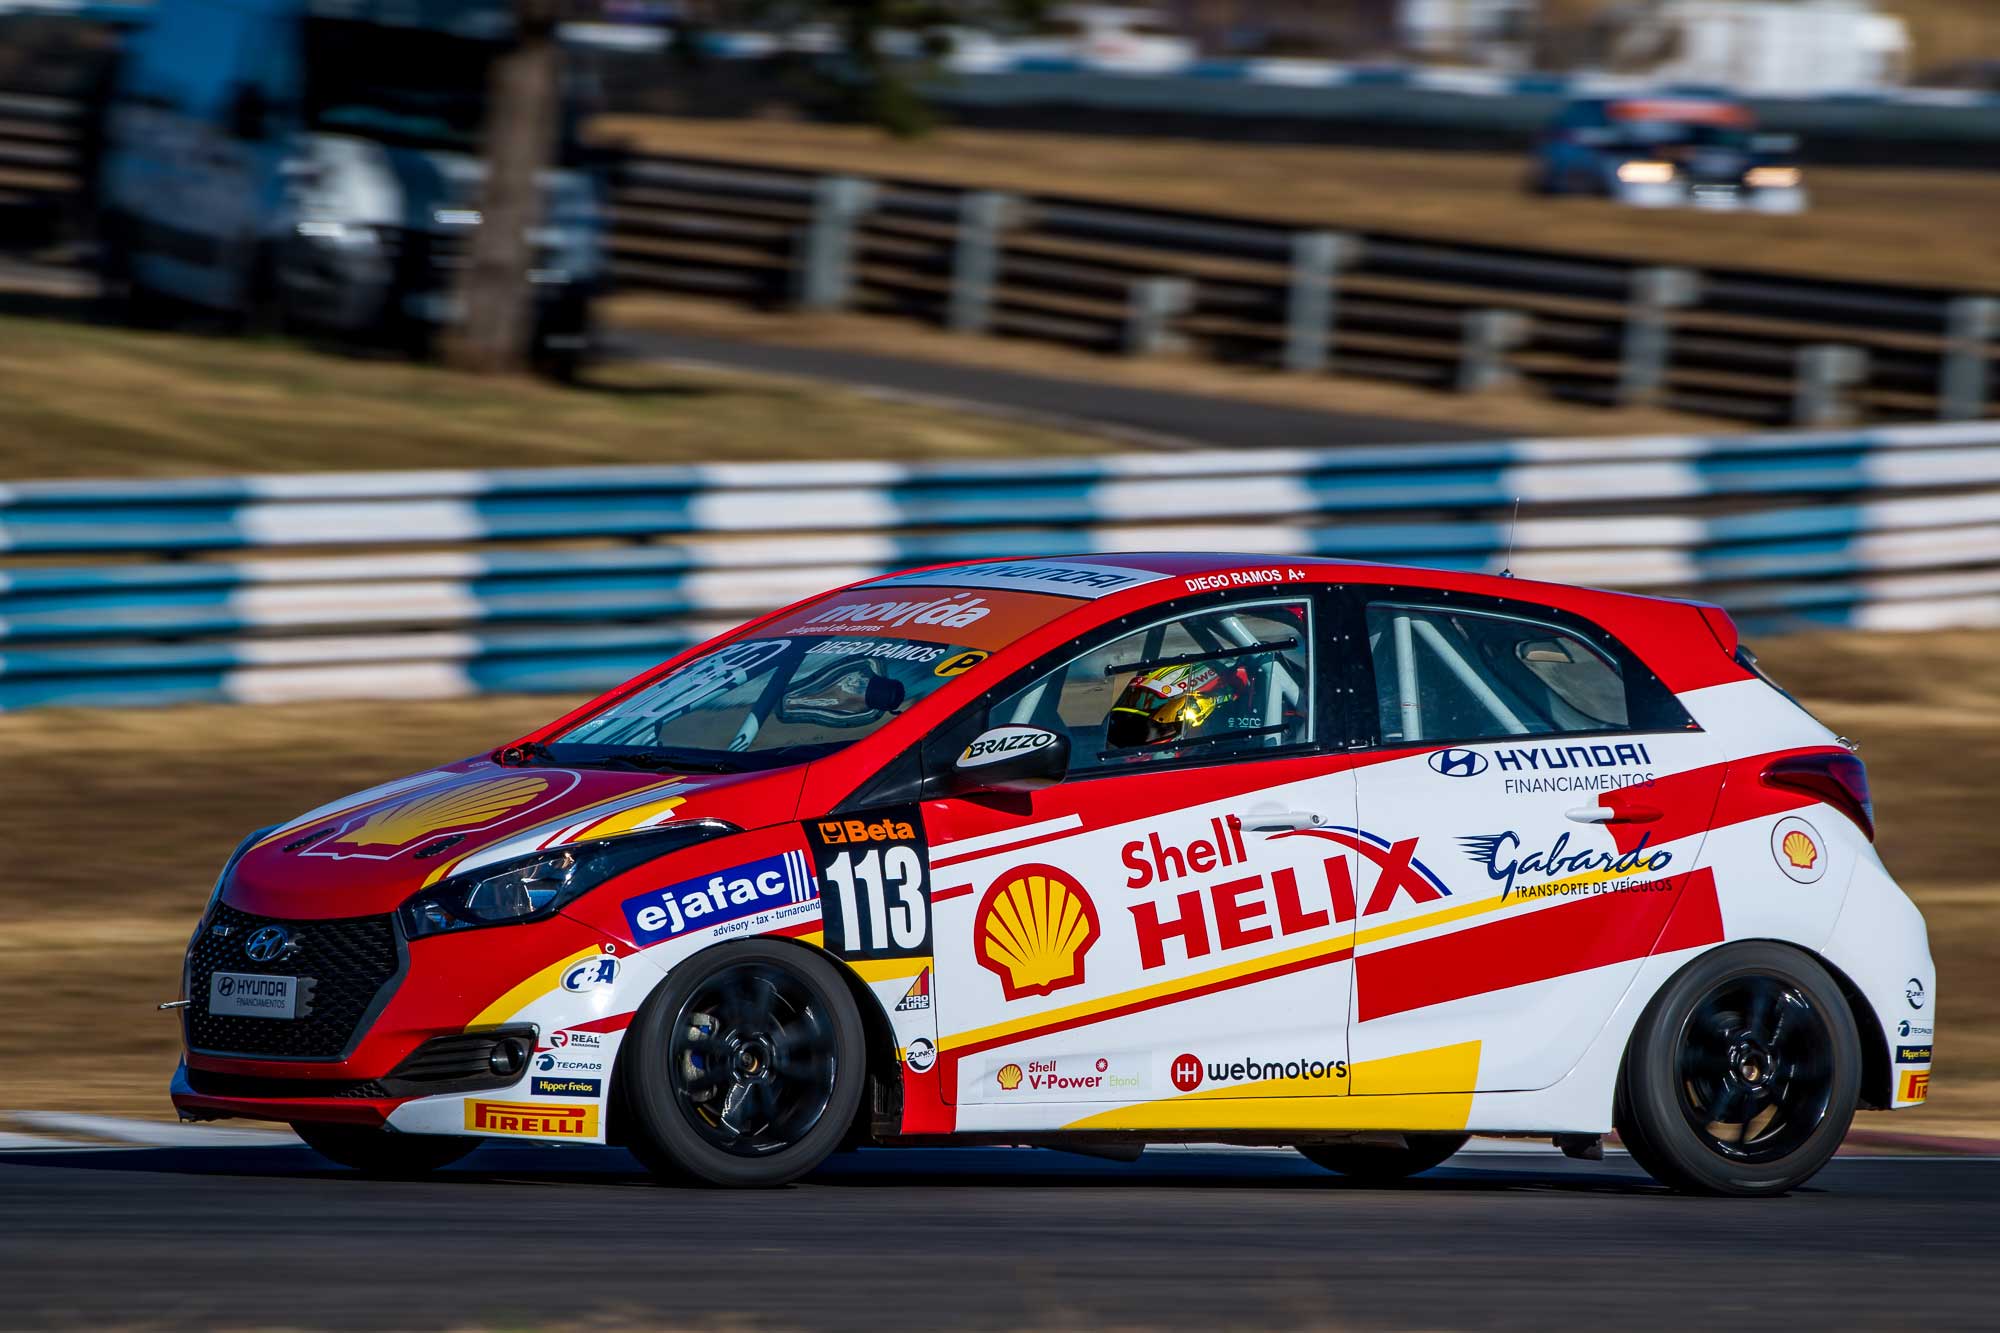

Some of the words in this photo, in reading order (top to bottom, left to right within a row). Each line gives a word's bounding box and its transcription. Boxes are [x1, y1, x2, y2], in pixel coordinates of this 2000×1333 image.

[1185, 574, 1229, 592] DIEGO
[1230, 569, 1282, 585] RAMOS
[1288, 568, 1305, 581] A+
[805, 641, 875, 655] DIEGO
[864, 643, 945, 663] RAMOS
[938, 653, 984, 675] P
[967, 733, 1052, 759] BRAZZO
[1494, 743, 1651, 771] HYUNDAI
[1505, 773, 1655, 794] FINANCIAMENTOS
[844, 818, 916, 843] Beta
[1121, 814, 1248, 889] Shell
[1487, 830, 1673, 902] Gabardo
[826, 846, 926, 951] 113
[1515, 882, 1589, 899] TRANSPORTE
[1592, 882, 1608, 894] DE
[1611, 877, 1673, 894] VEÍCULOS
[637, 870, 785, 933] ejafac
[1127, 836, 1444, 970] HELIX
[713, 919, 749, 938] advisory
[756, 914, 769, 925] tax
[776, 901, 821, 920] turnaround
[566, 959, 616, 990] CBA
[237, 979, 287, 997] HYUNDAI
[906, 995, 929, 1003] PRO
[899, 1001, 929, 1010] TUNE
[571, 1034, 600, 1044] REAL
[557, 1061, 602, 1069] TECPADS
[907, 1048, 936, 1061] ZUNKY
[1028, 1060, 1057, 1073] Shell
[1207, 1057, 1347, 1081] webmotors
[540, 1081, 568, 1092] Hipper
[569, 1082, 593, 1092] Freios
[1028, 1074, 1102, 1090] V-Power
[475, 1102, 586, 1134] PIRELLI
